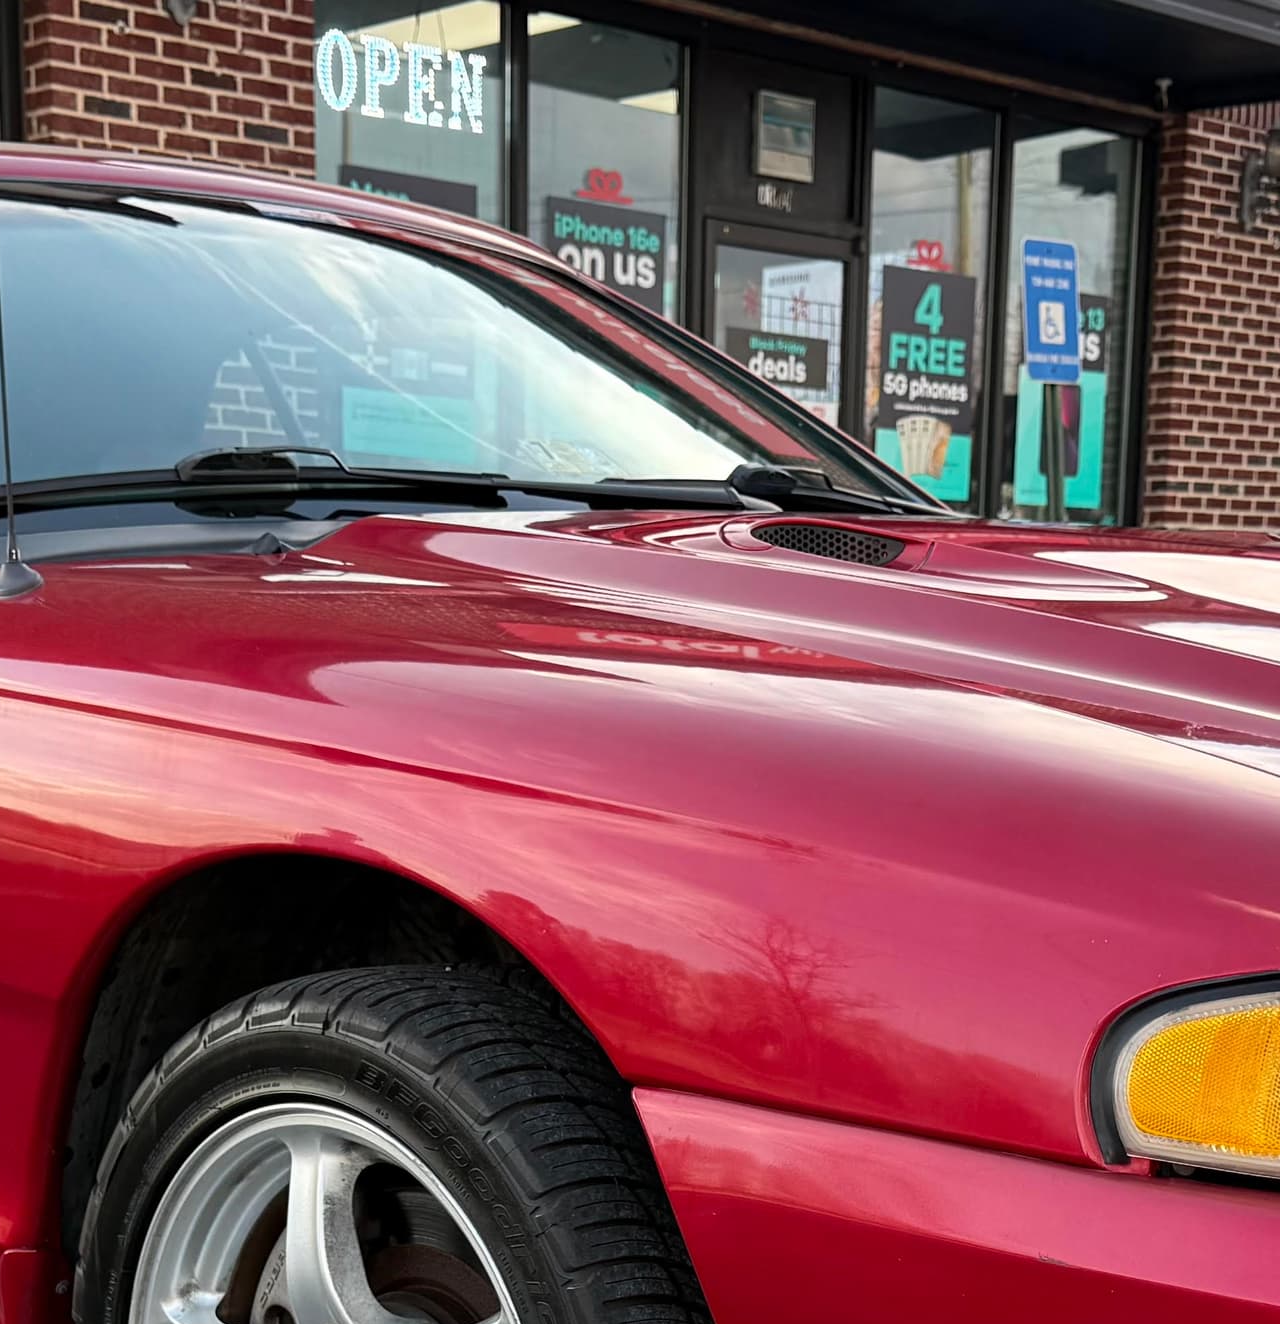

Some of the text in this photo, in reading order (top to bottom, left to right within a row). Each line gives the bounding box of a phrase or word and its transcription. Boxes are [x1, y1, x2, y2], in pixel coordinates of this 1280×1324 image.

[316, 28, 487, 134] OPEN
[554, 212, 660, 254] iPhone 16e
[557, 243, 656, 289] on us
[914, 283, 943, 335] 4
[748, 351, 807, 384] deals
[888, 332, 967, 377] FREE
[883, 372, 968, 402] 5G phones
